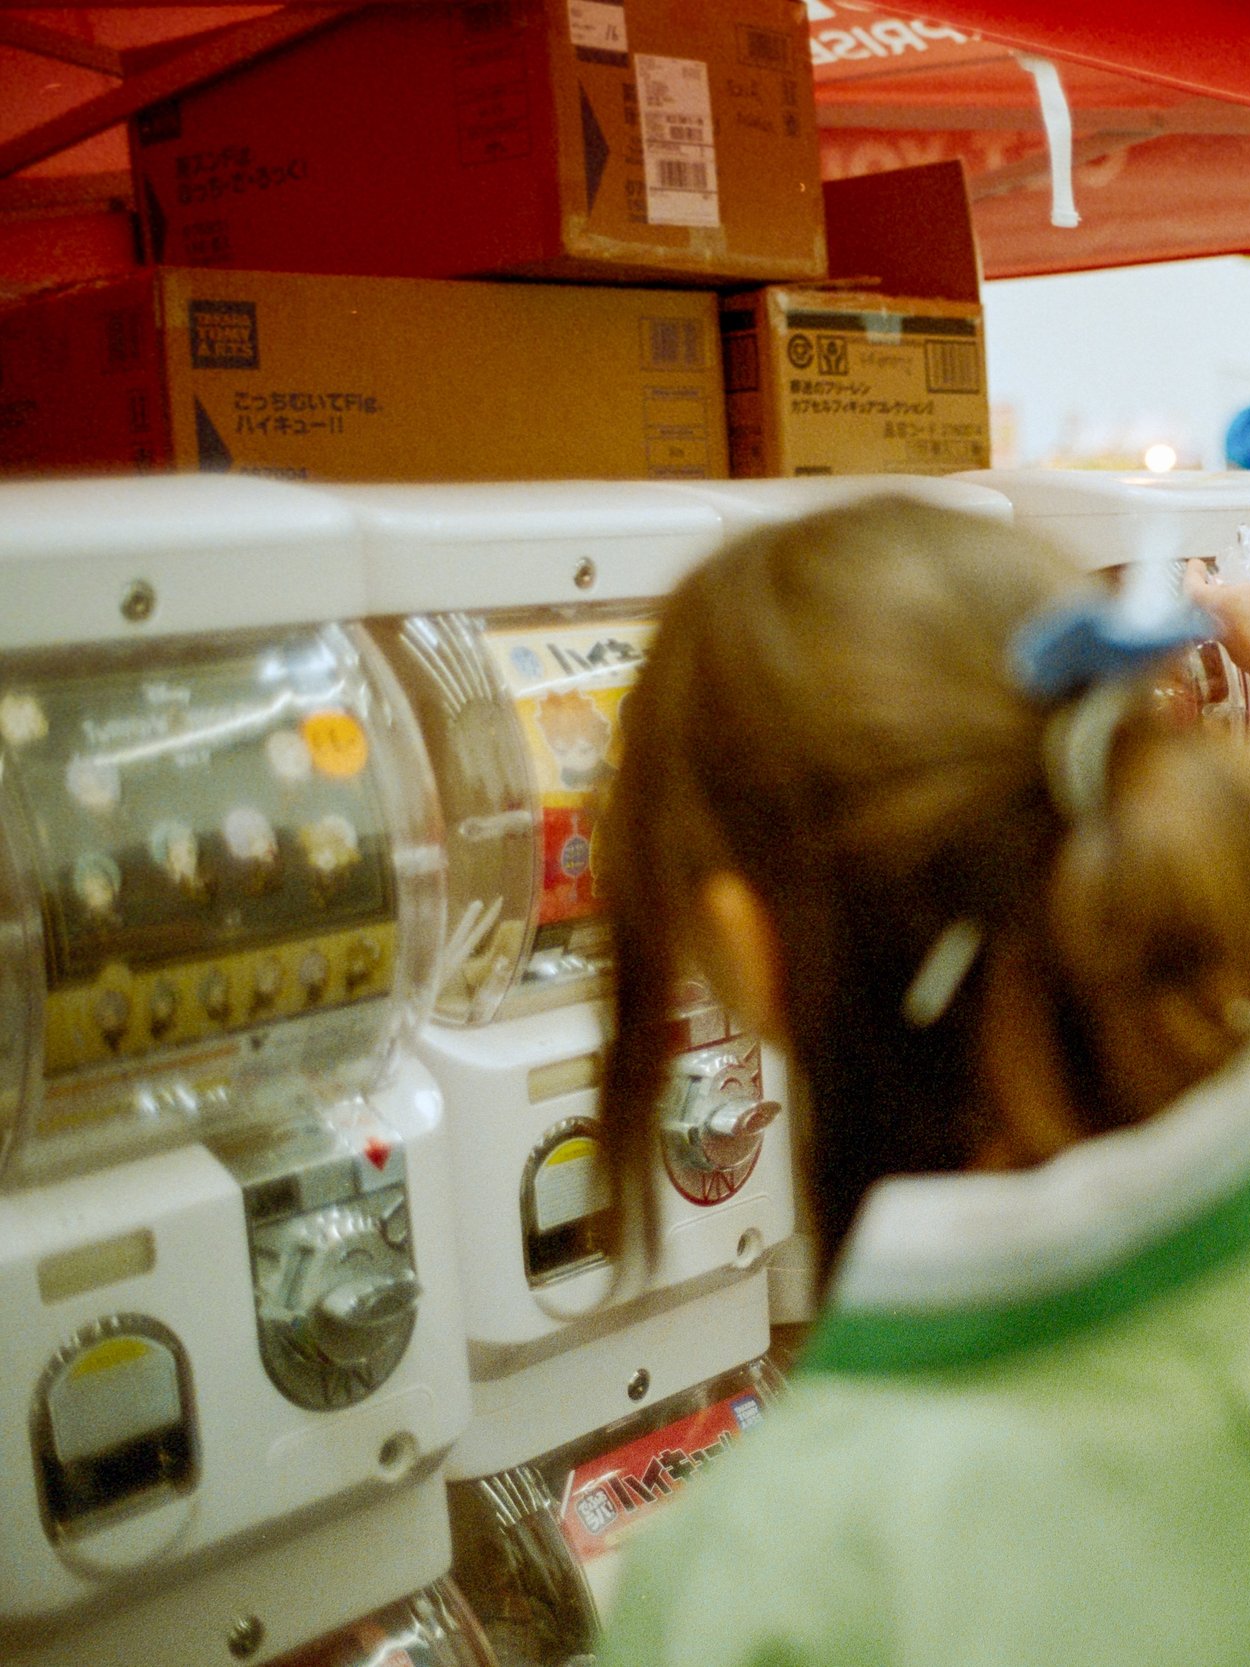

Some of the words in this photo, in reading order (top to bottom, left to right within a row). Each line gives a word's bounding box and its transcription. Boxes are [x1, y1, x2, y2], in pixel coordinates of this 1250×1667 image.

[236, 415, 344, 434] ハイキュー!!
